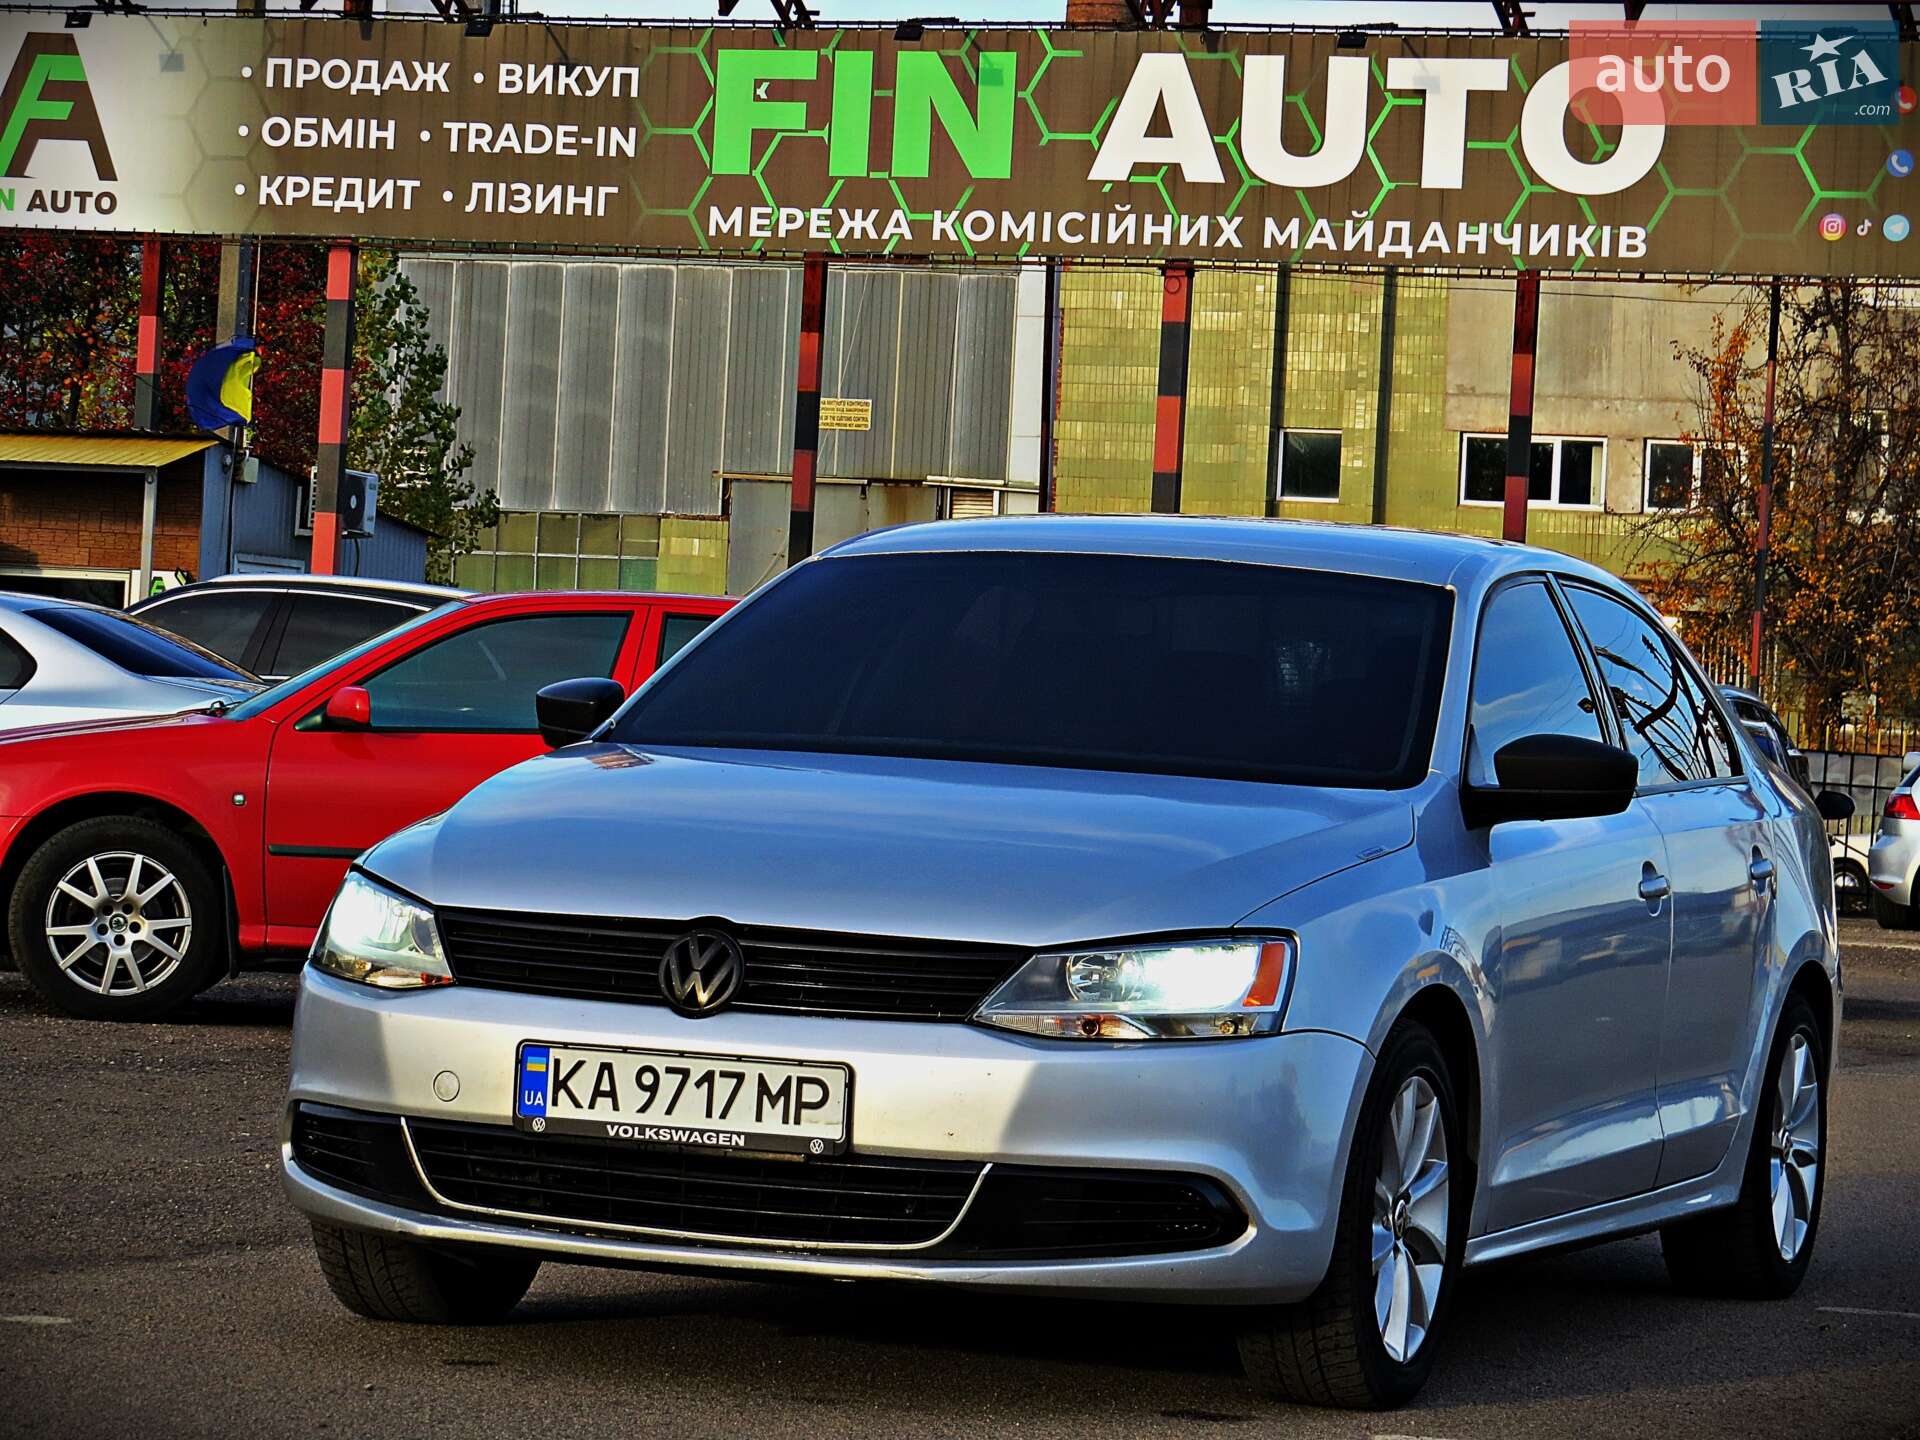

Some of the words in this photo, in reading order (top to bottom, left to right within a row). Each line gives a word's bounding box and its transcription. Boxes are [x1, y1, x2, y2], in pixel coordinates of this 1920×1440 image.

[265, 57, 451, 96] ПРОДАЖ
[498, 63, 640, 98] ВИКУП
[261, 116, 396, 150] ОБМІН
[443, 121, 637, 158] TRADE-IN
[711, 48, 1017, 180] FIN
[1086, 51, 1667, 196] AUTO
[26, 189, 118, 215] AUTO
[258, 175, 421, 214] КРЕДИТ
[464, 182, 619, 217] ЛІЗИНГ
[708, 205, 913, 241] МЕРЕЖА
[932, 203, 1243, 249] КОМІСІЙНИХ
[1263, 209, 1648, 259] МАЙДАНЧИКІВ
[524, 1090, 544, 1107] UA
[551, 1057, 620, 1112] KA
[635, 1064, 746, 1120] 9717
[755, 1072, 830, 1126] MP
[606, 1123, 745, 1147] VOLKSWAGEN
